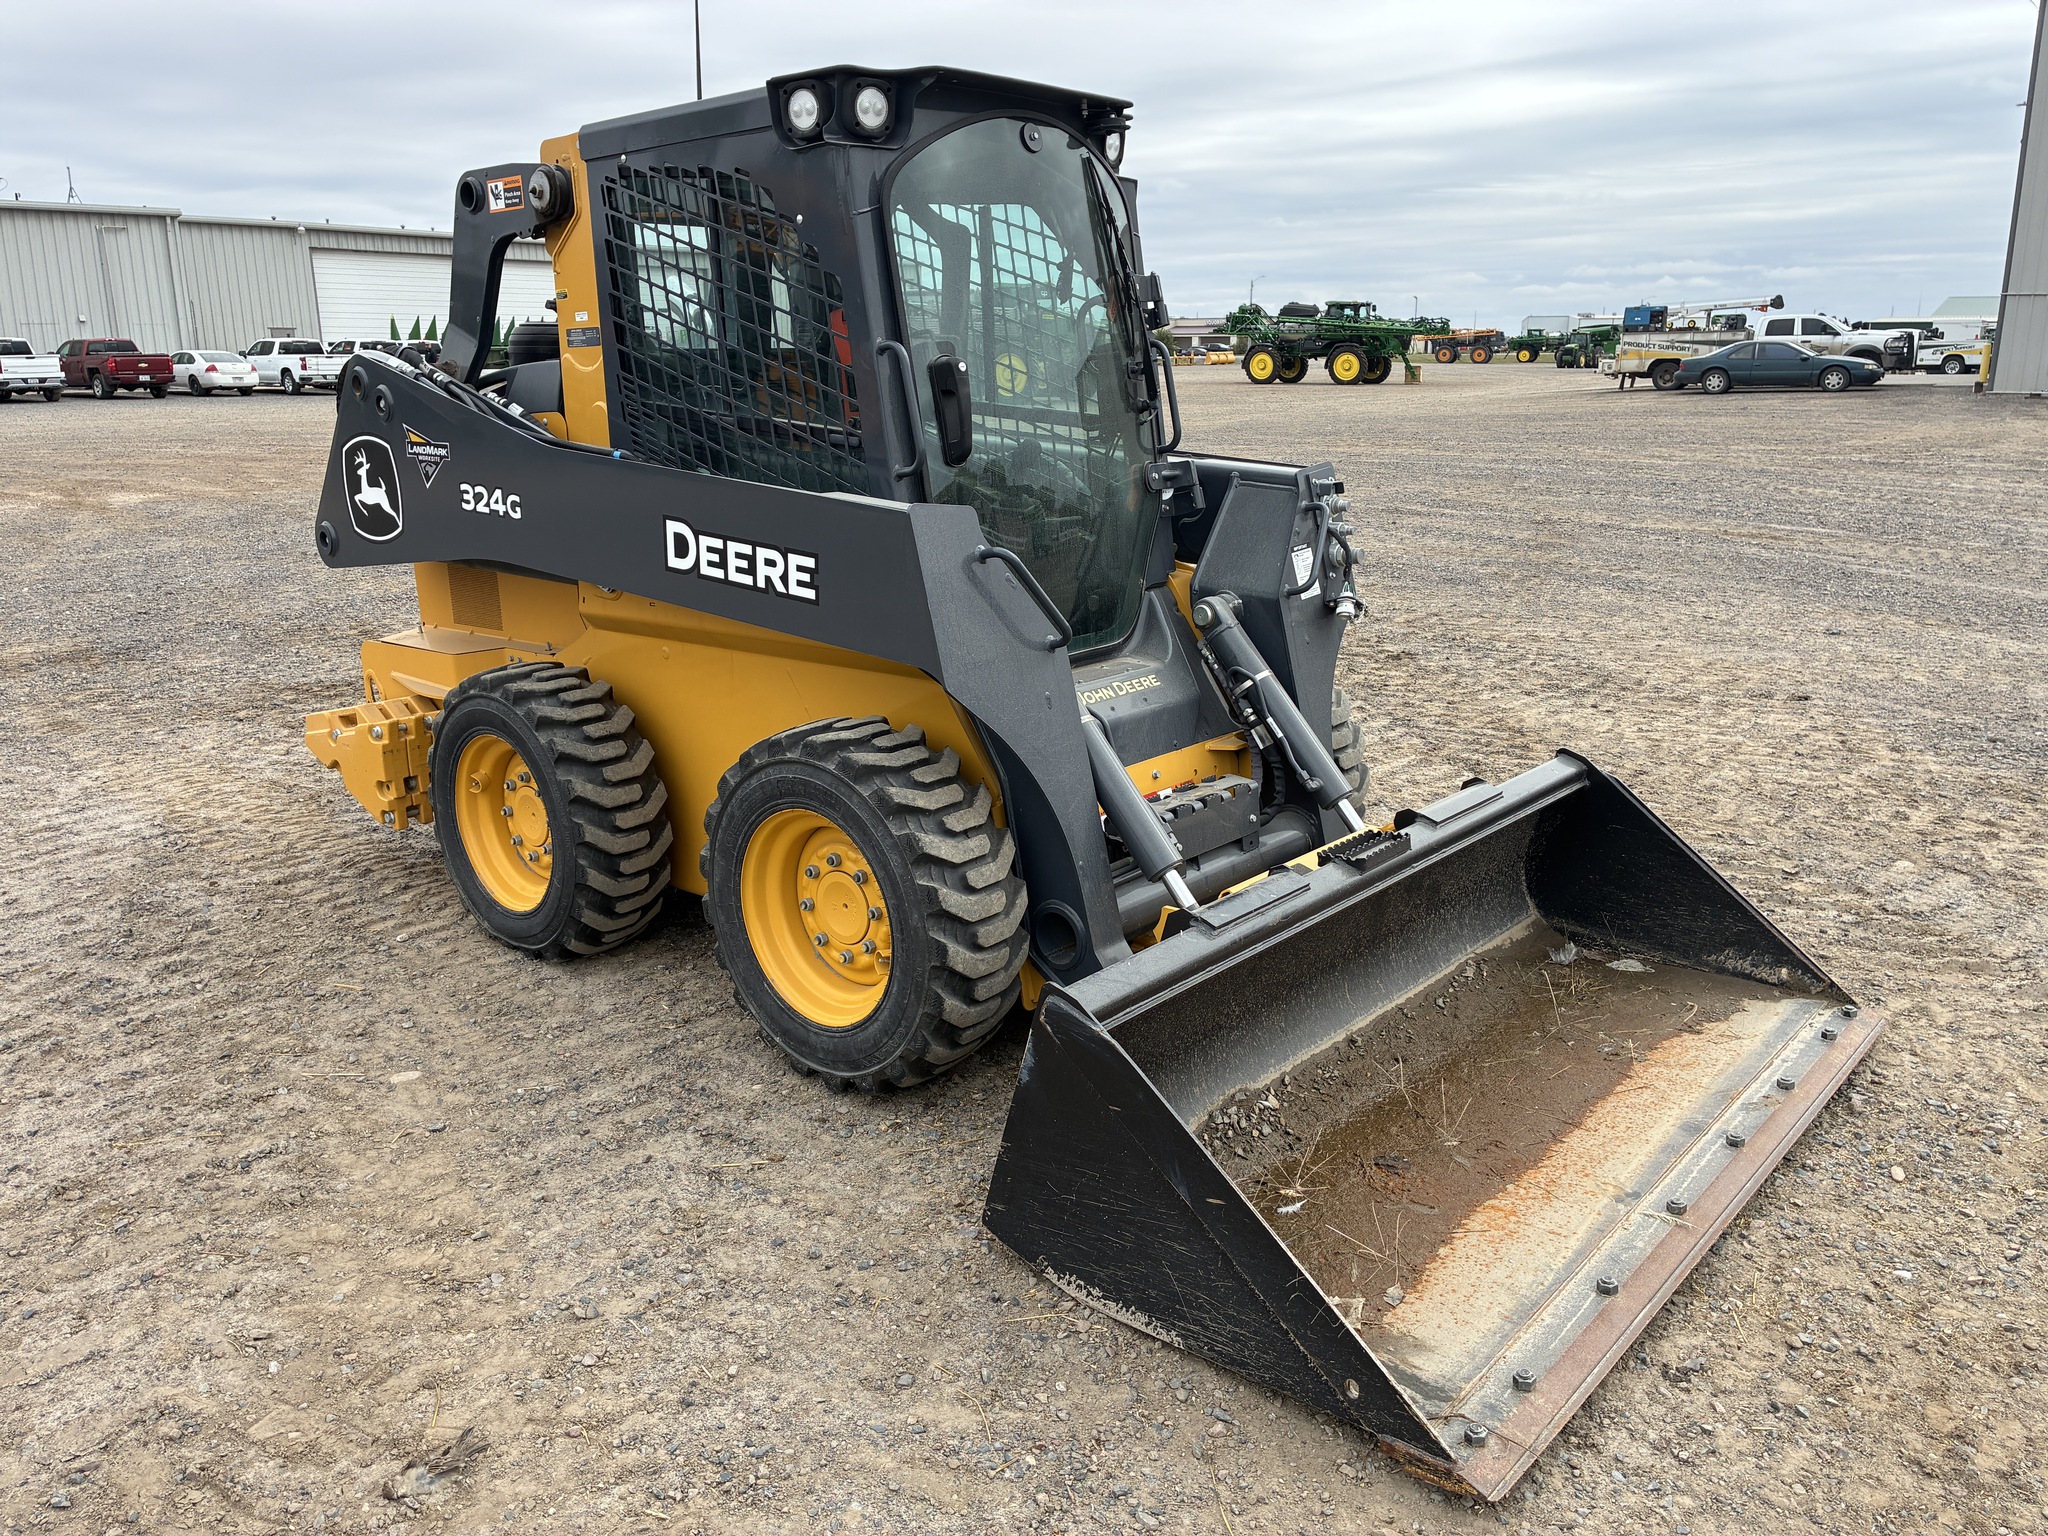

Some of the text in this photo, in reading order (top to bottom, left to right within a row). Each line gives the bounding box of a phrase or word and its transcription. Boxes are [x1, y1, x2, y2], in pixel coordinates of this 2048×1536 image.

[1623, 340, 1692, 352] PRODUCT SUPPORT
[418, 455, 441, 463] WORKSITE
[459, 483, 522, 519] 324G
[665, 519, 816, 600] DEERE
[1077, 674, 1162, 705] JOHN DEERE
